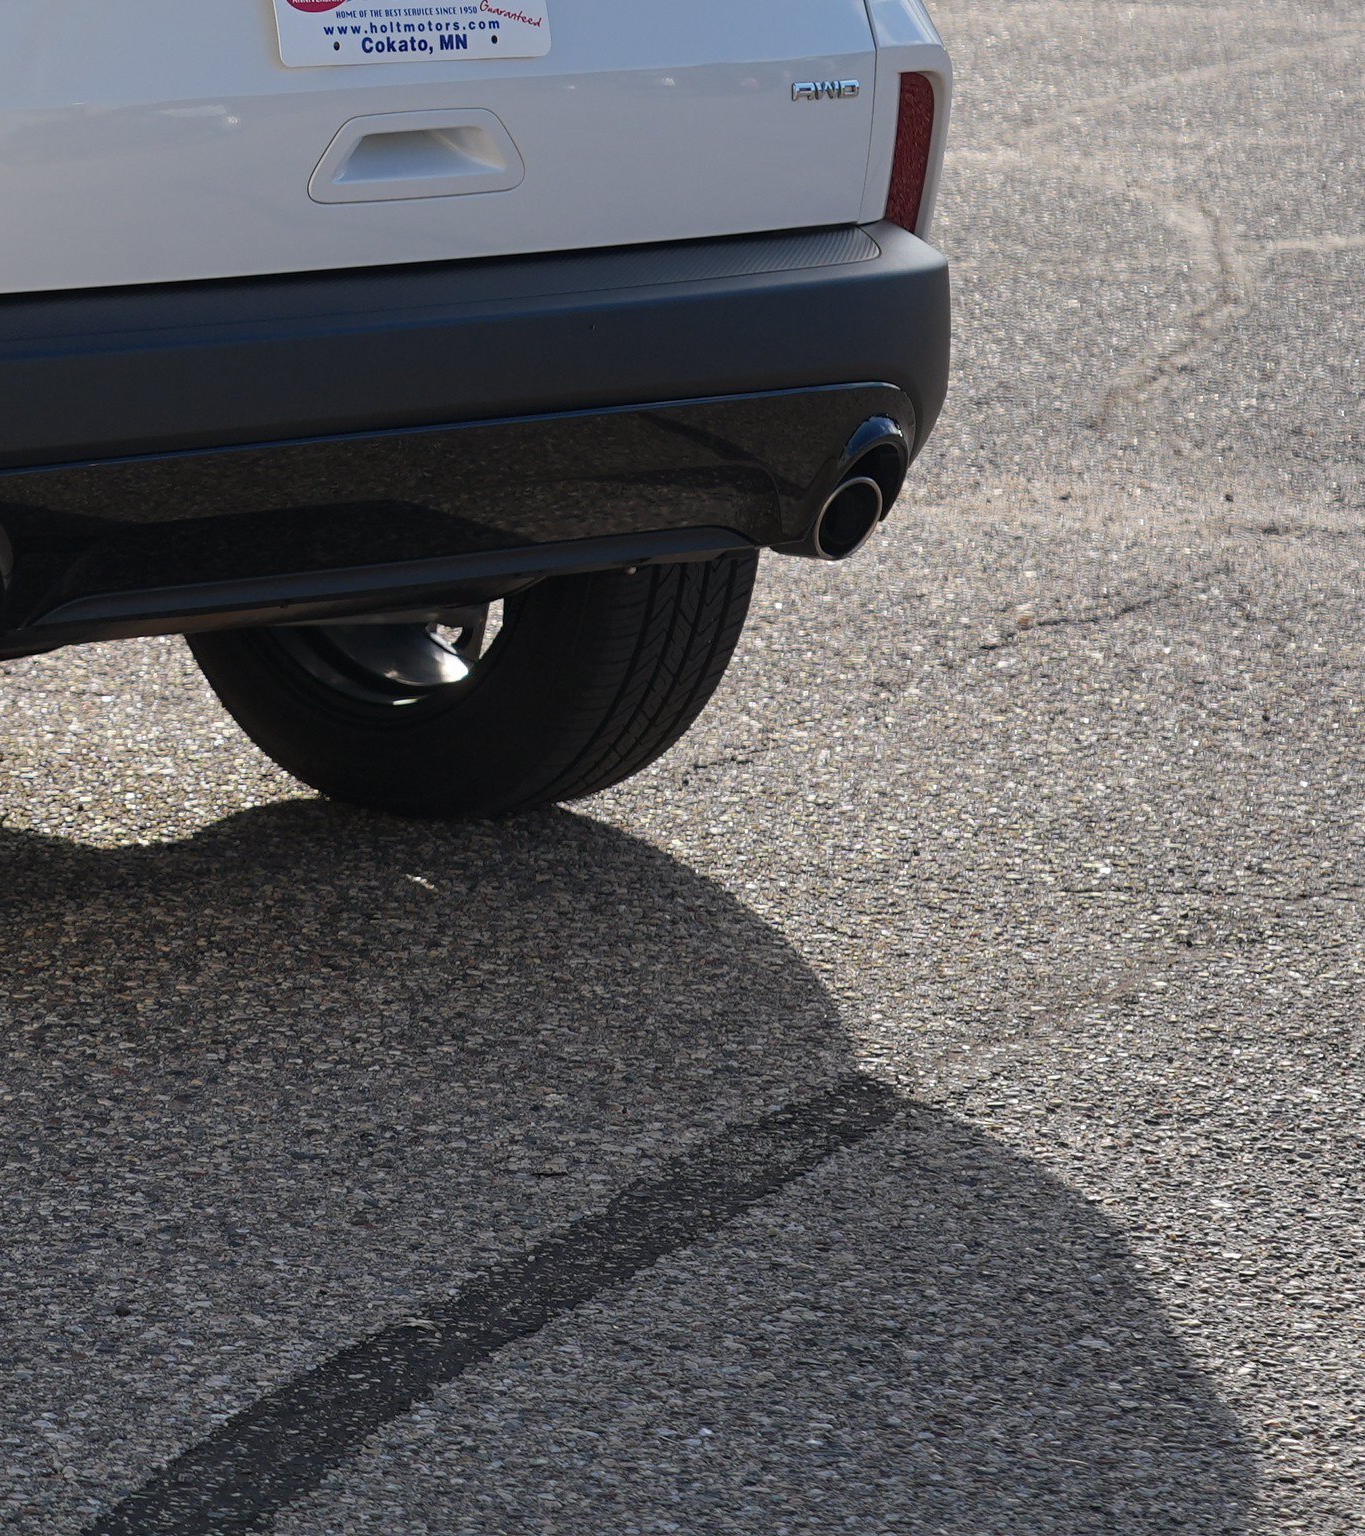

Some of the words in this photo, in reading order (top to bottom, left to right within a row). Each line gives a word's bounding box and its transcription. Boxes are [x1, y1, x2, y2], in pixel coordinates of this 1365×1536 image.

[336, 10, 358, 19] HOME
[359, 10, 367, 18] OF
[370, 9, 383, 18] THE
[384, 9, 402, 17] BEST
[404, 7, 433, 16] SERVICE
[435, 6, 457, 15] SINCE
[459, 6, 478, 14] 1950
[480, 0, 542, 28] Guaranteed
[323, 19, 500, 35] www.holtmotors.com
[361, 36, 433, 54] Cokato,
[439, 34, 468, 50] MN
[791, 79, 860, 101] AWD
